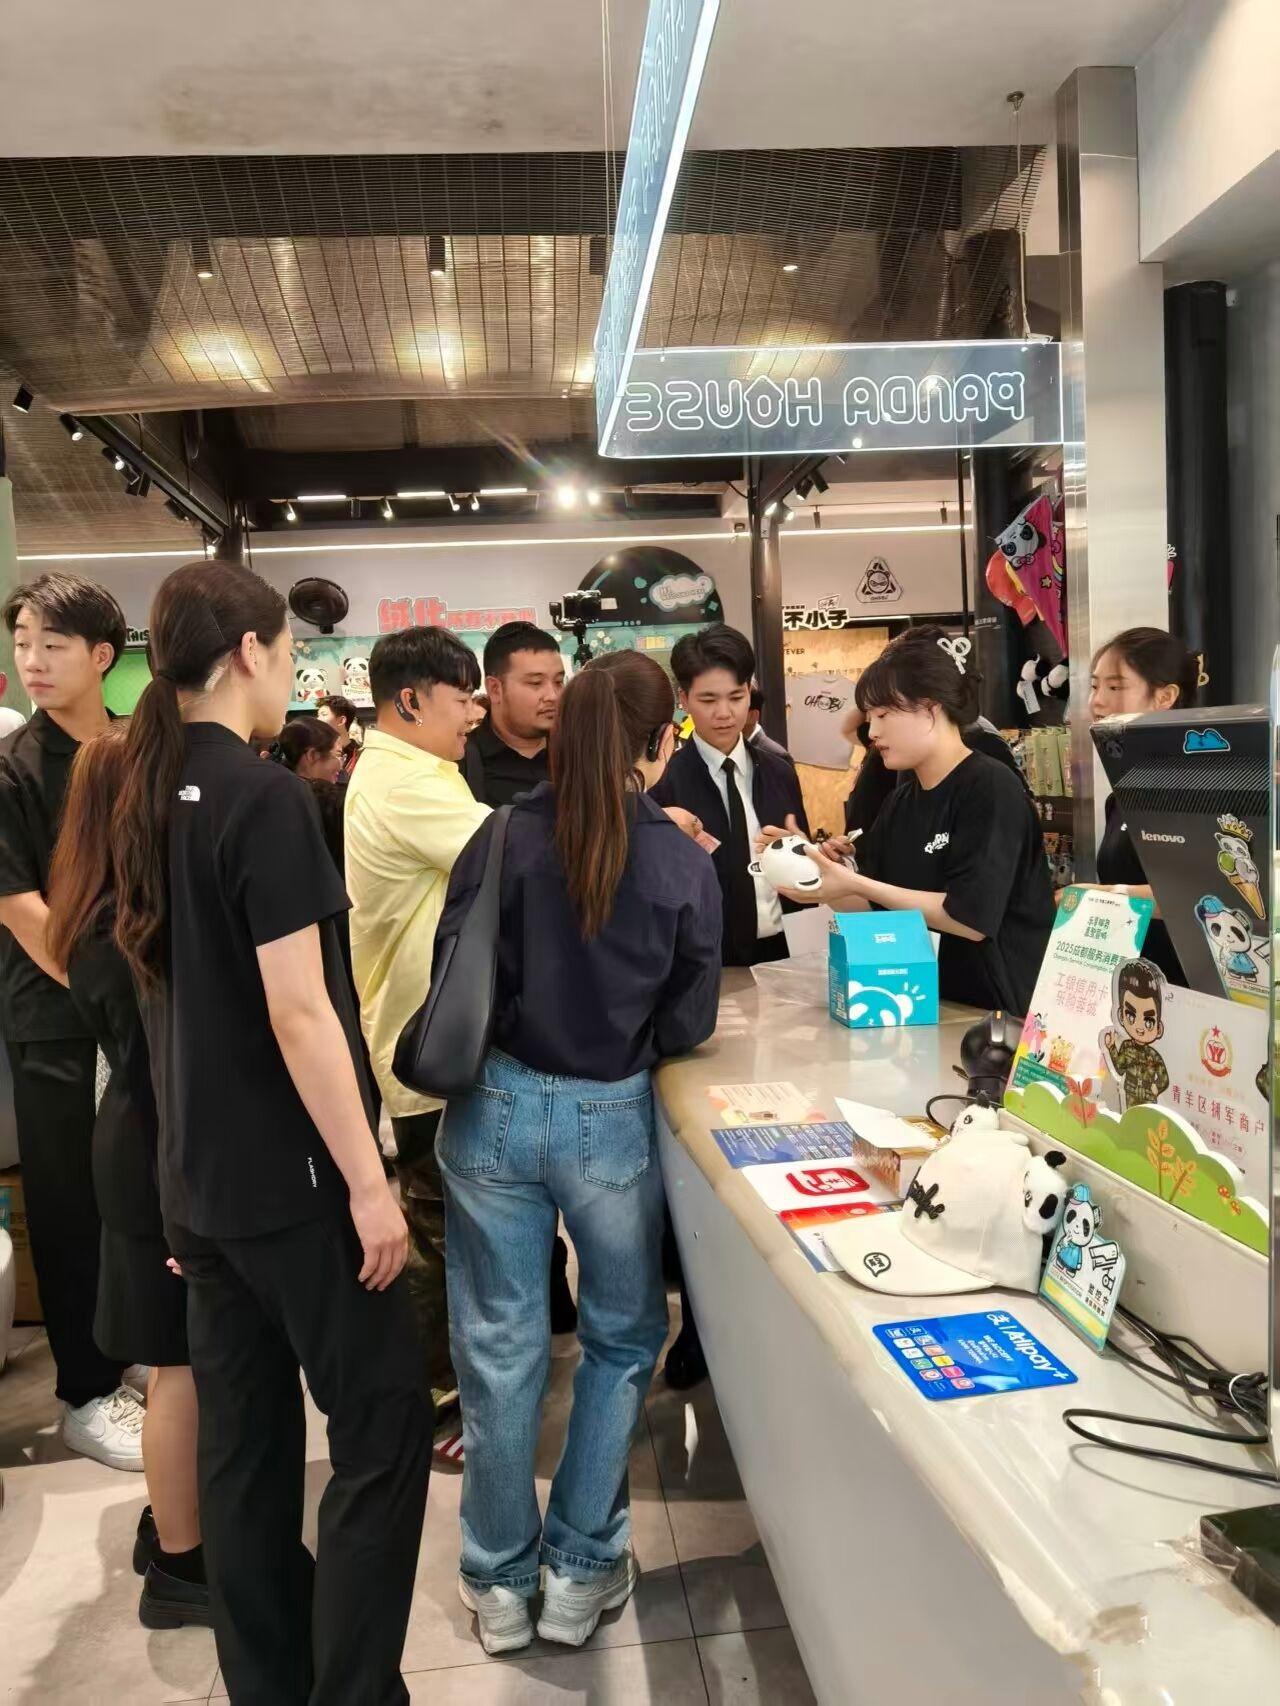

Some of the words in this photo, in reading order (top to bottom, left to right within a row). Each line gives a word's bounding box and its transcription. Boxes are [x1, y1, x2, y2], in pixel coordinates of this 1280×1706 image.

[1141, 830, 1186, 844] lenovo
[1171, 1085, 1265, 1136] 青羊区拥军商户
[1087, 1282, 1109, 1307] 监控中
